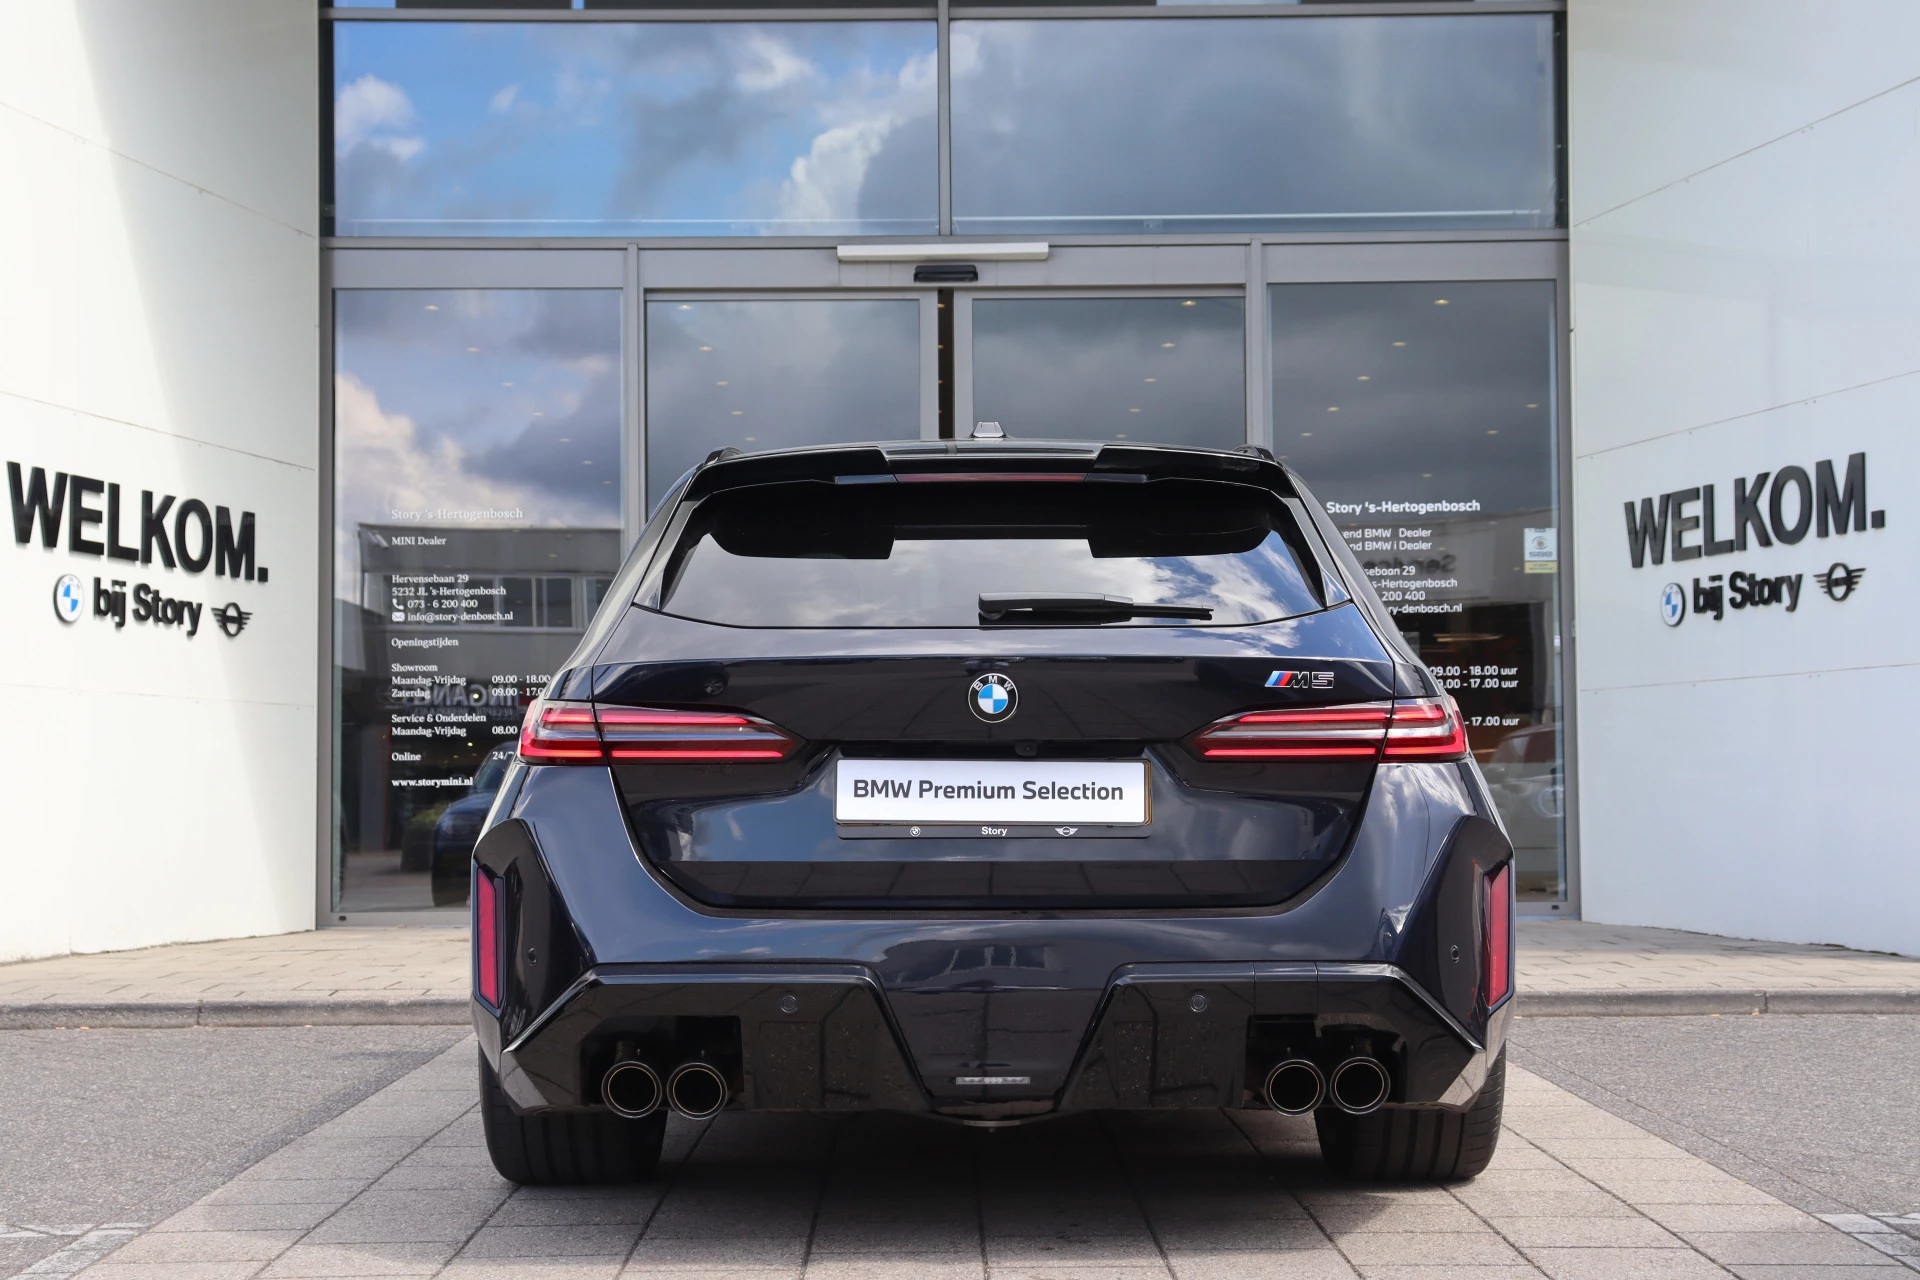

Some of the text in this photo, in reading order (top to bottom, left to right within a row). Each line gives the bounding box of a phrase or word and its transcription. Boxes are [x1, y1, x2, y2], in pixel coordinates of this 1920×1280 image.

[1326, 501, 1362, 515] Story
[1624, 452, 1885, 568] WELKOM.
[391, 509, 422, 521] Story
[6, 460, 269, 583] WELKOM.
[1342, 528, 1432, 539] end BMW Dealer
[392, 536, 447, 545] MINI Dealer
[1365, 541, 1392, 551] BMW
[1394, 541, 1397, 550] i
[1399, 540, 1432, 550] Dealer
[1401, 566, 1416, 576] 29
[392, 574, 469, 583] Hervensebaan 29
[1372, 579, 1457, 589] s-Hertogenbosch
[391, 587, 415, 596] 5232
[417, 587, 428, 596] JL
[1381, 591, 1426, 601] 200 400
[1692, 571, 1803, 620] bij Story
[93, 577, 202, 637] bij Story
[407, 600, 425, 608] 073
[432, 600, 439, 608] 6
[441, 600, 459, 608] 200
[460, 600, 478, 608] 400
[1388, 604, 1462, 615] ry-denbosch.nl
[407, 611, 514, 623] info@story-denbosch.nl
[391, 638, 459, 647] Openingstijden
[391, 663, 438, 672] Showroom
[1469, 665, 1499, 676] 18.00
[1500, 667, 1518, 675] uur
[391, 675, 466, 686] Maandag-Vrijdag
[491, 675, 517, 684] 09.00
[973, 676, 1013, 691] BMW
[1286, 671, 1334, 689] M5
[1501, 680, 1519, 688] uur
[391, 688, 431, 699] Zaterdag
[491, 687, 517, 696] 09.00
[526, 687, 543, 696] 17.0
[391, 713, 486, 723] Service & Onderdelen
[1502, 718, 1520, 726] uur
[391, 726, 518, 737] Maandag-Vrijdag 08.00
[391, 752, 422, 761] Online
[392, 777, 474, 788] www.storymini.nl
[853, 779, 1124, 800] BMW Premium Selection
[981, 827, 1007, 836] Story
